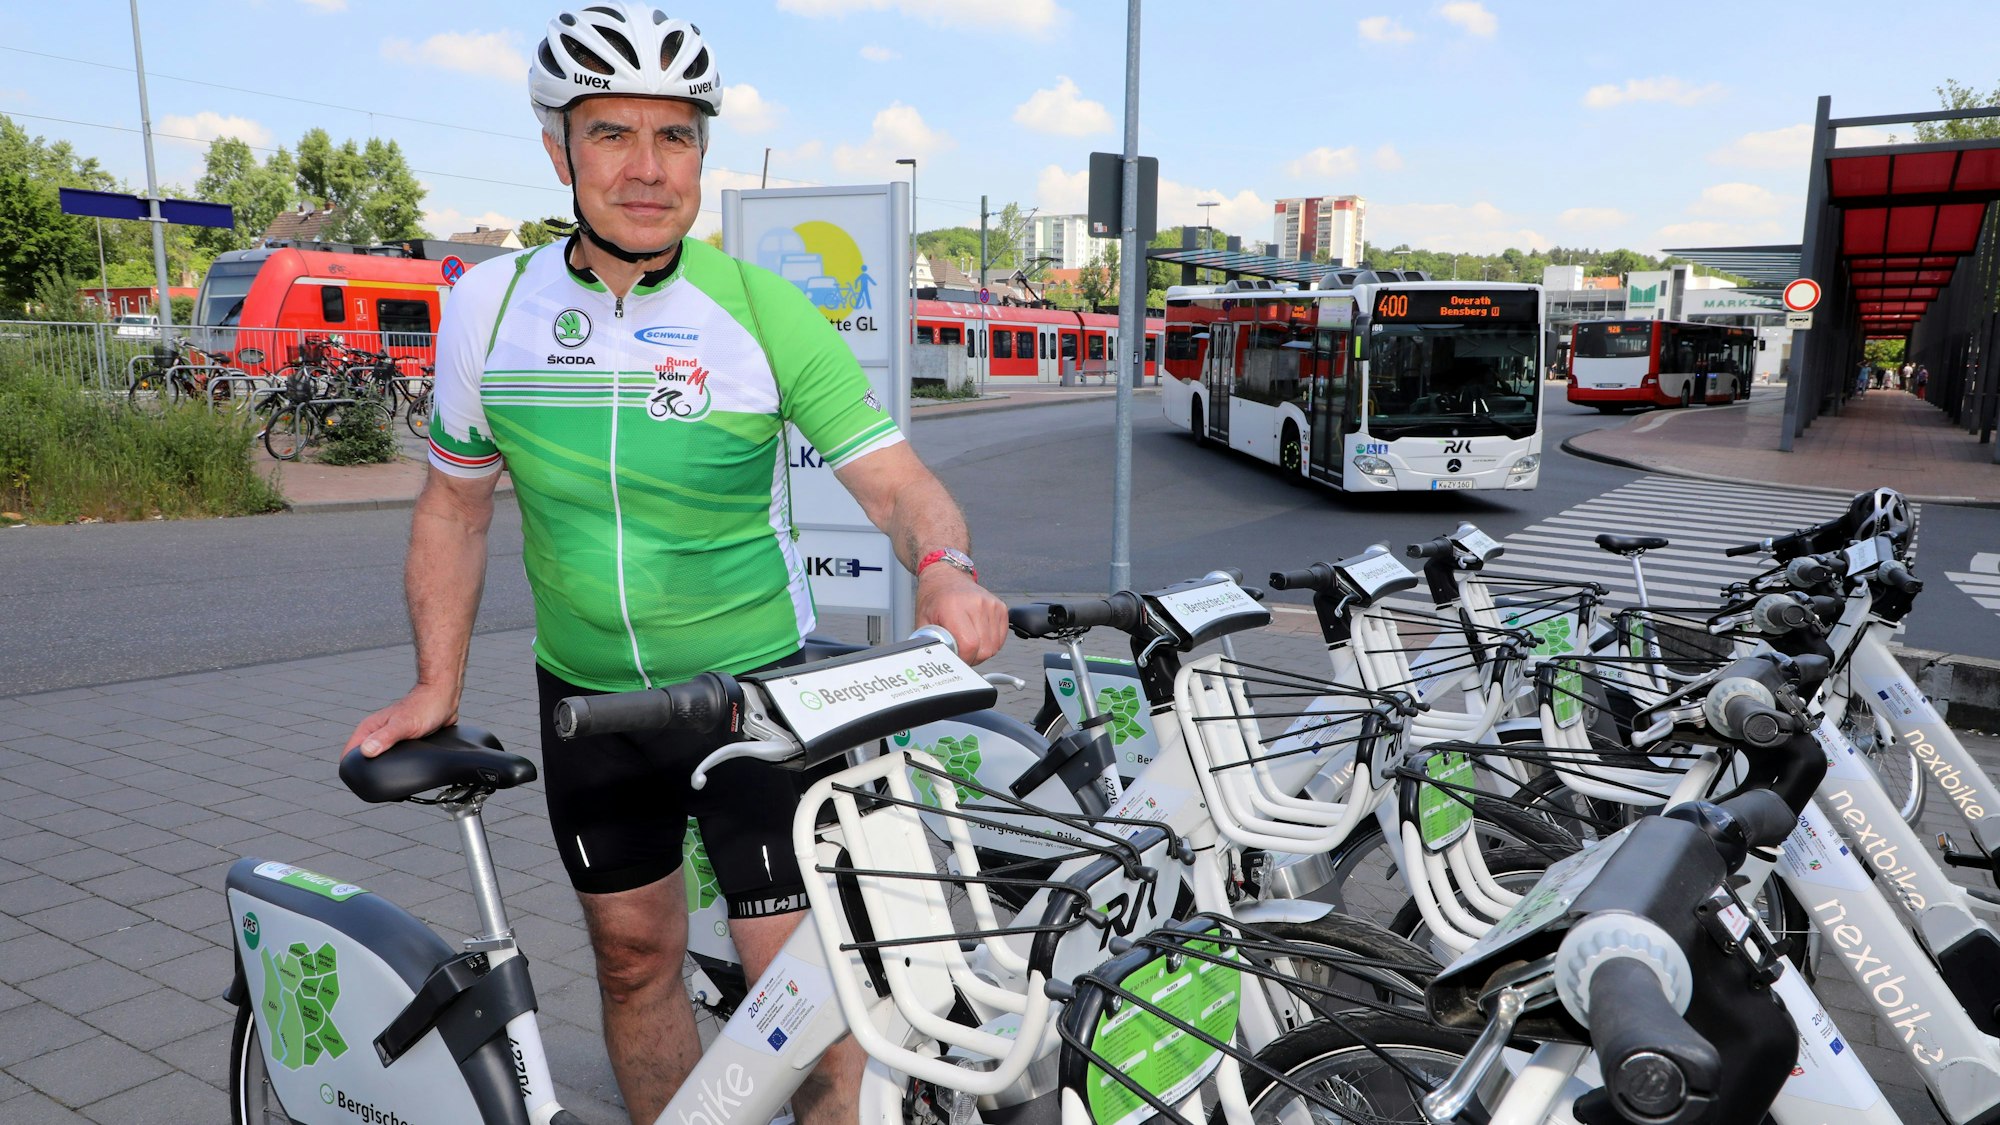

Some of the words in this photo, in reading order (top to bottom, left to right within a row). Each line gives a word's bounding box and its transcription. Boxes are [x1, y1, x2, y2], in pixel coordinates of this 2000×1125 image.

[574, 73, 611, 90] uvex
[689, 81, 713, 95] uvex
[357, 300, 364, 314] 1
[1378, 295, 1408, 317] 400
[1451, 296, 1491, 305] Overath
[1704, 299, 1783, 308] MARKTKA
[1440, 307, 1487, 316] Bensberg
[856, 316, 878, 331] GL
[646, 331, 699, 341] SCHWALBE
[547, 354, 595, 365] ŠKODA
[666, 357, 697, 367] Rund
[659, 372, 686, 381] Köln
[806, 557, 851, 577] IKE
[818, 673, 908, 705] Bergisches
[904, 661, 954, 683] e-Bike
[891, 688, 913, 699] powered
[1904, 729, 1984, 820] nextbike
[1828, 790, 1926, 912] nextbike
[243, 916, 256, 933] VRS
[1814, 899, 1945, 1064] nextbike
[268, 1001, 277, 1011] Köln
